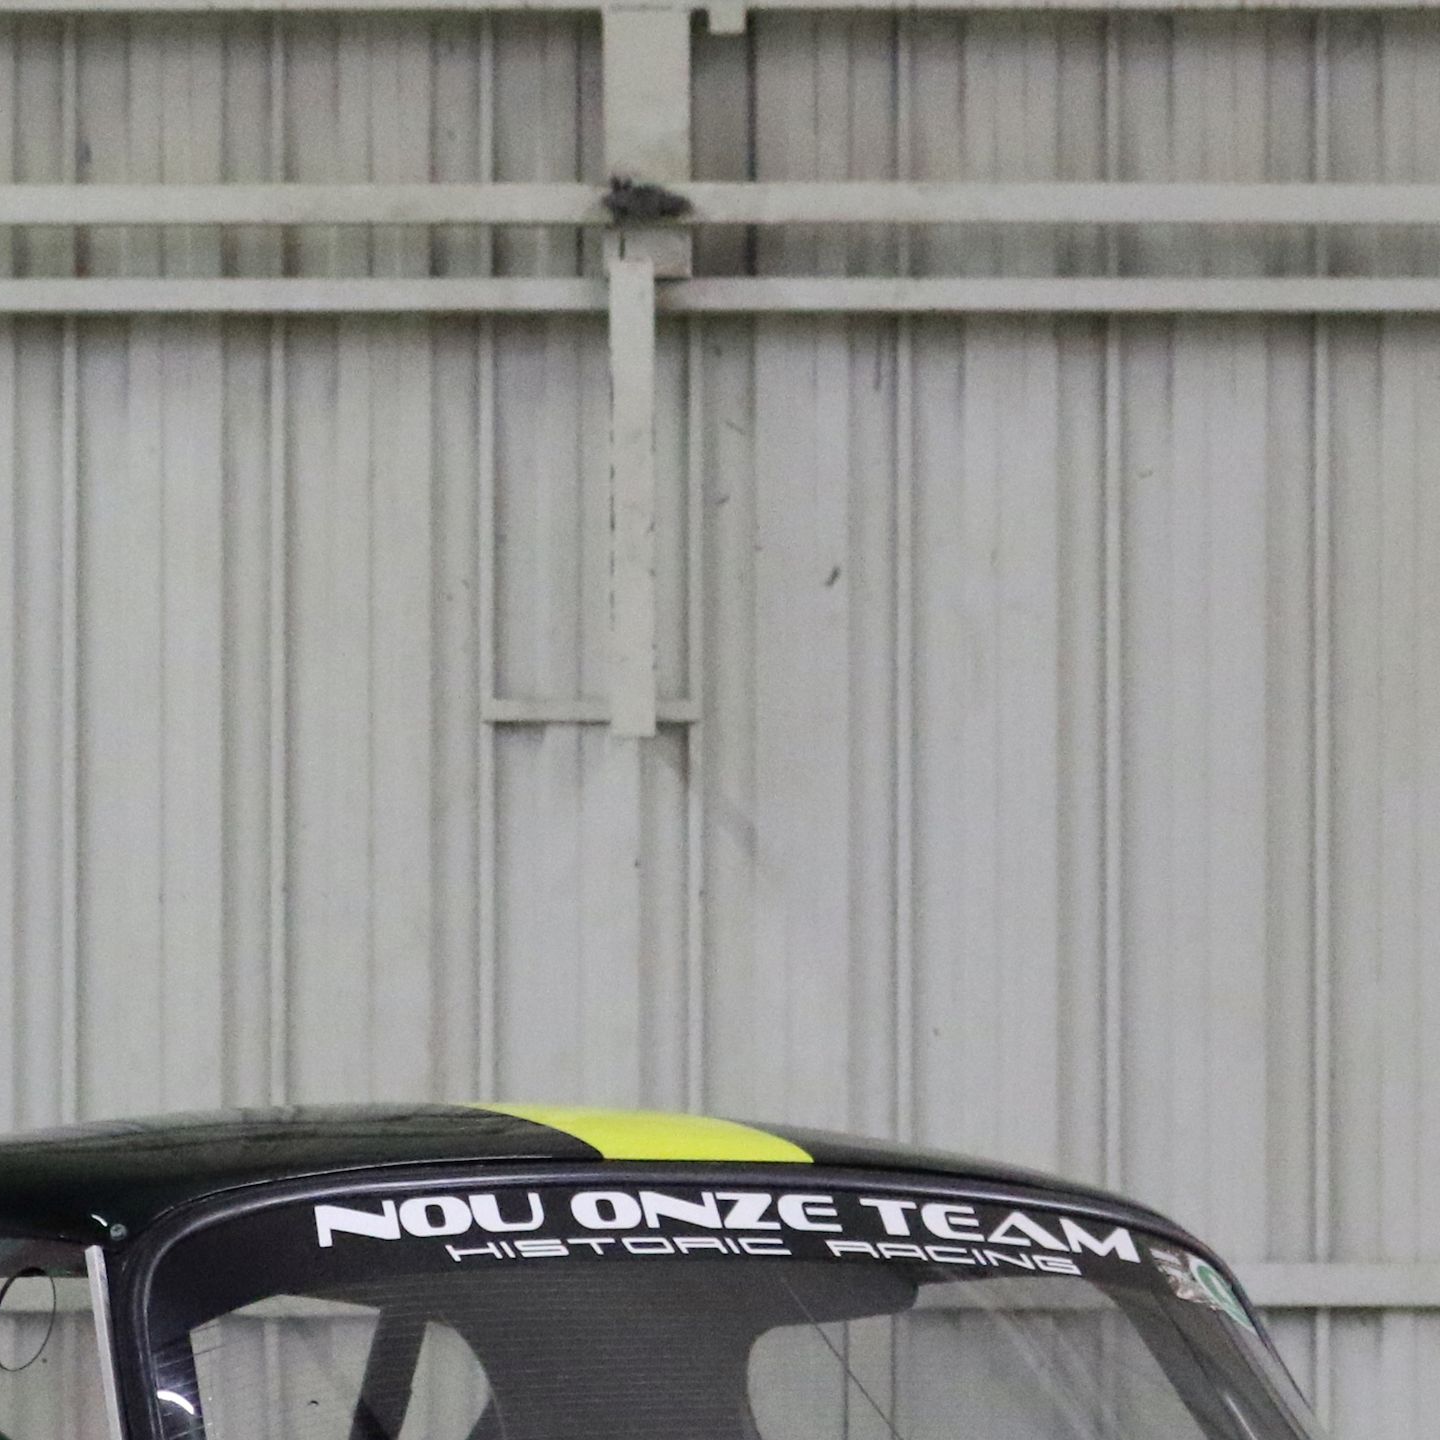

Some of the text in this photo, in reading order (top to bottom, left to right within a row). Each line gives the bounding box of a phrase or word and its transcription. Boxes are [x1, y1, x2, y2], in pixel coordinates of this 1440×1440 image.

[314, 1191, 1141, 1263] NOU ONZE TEAM
[444, 1237, 1082, 1275] HISTORIC RACING
